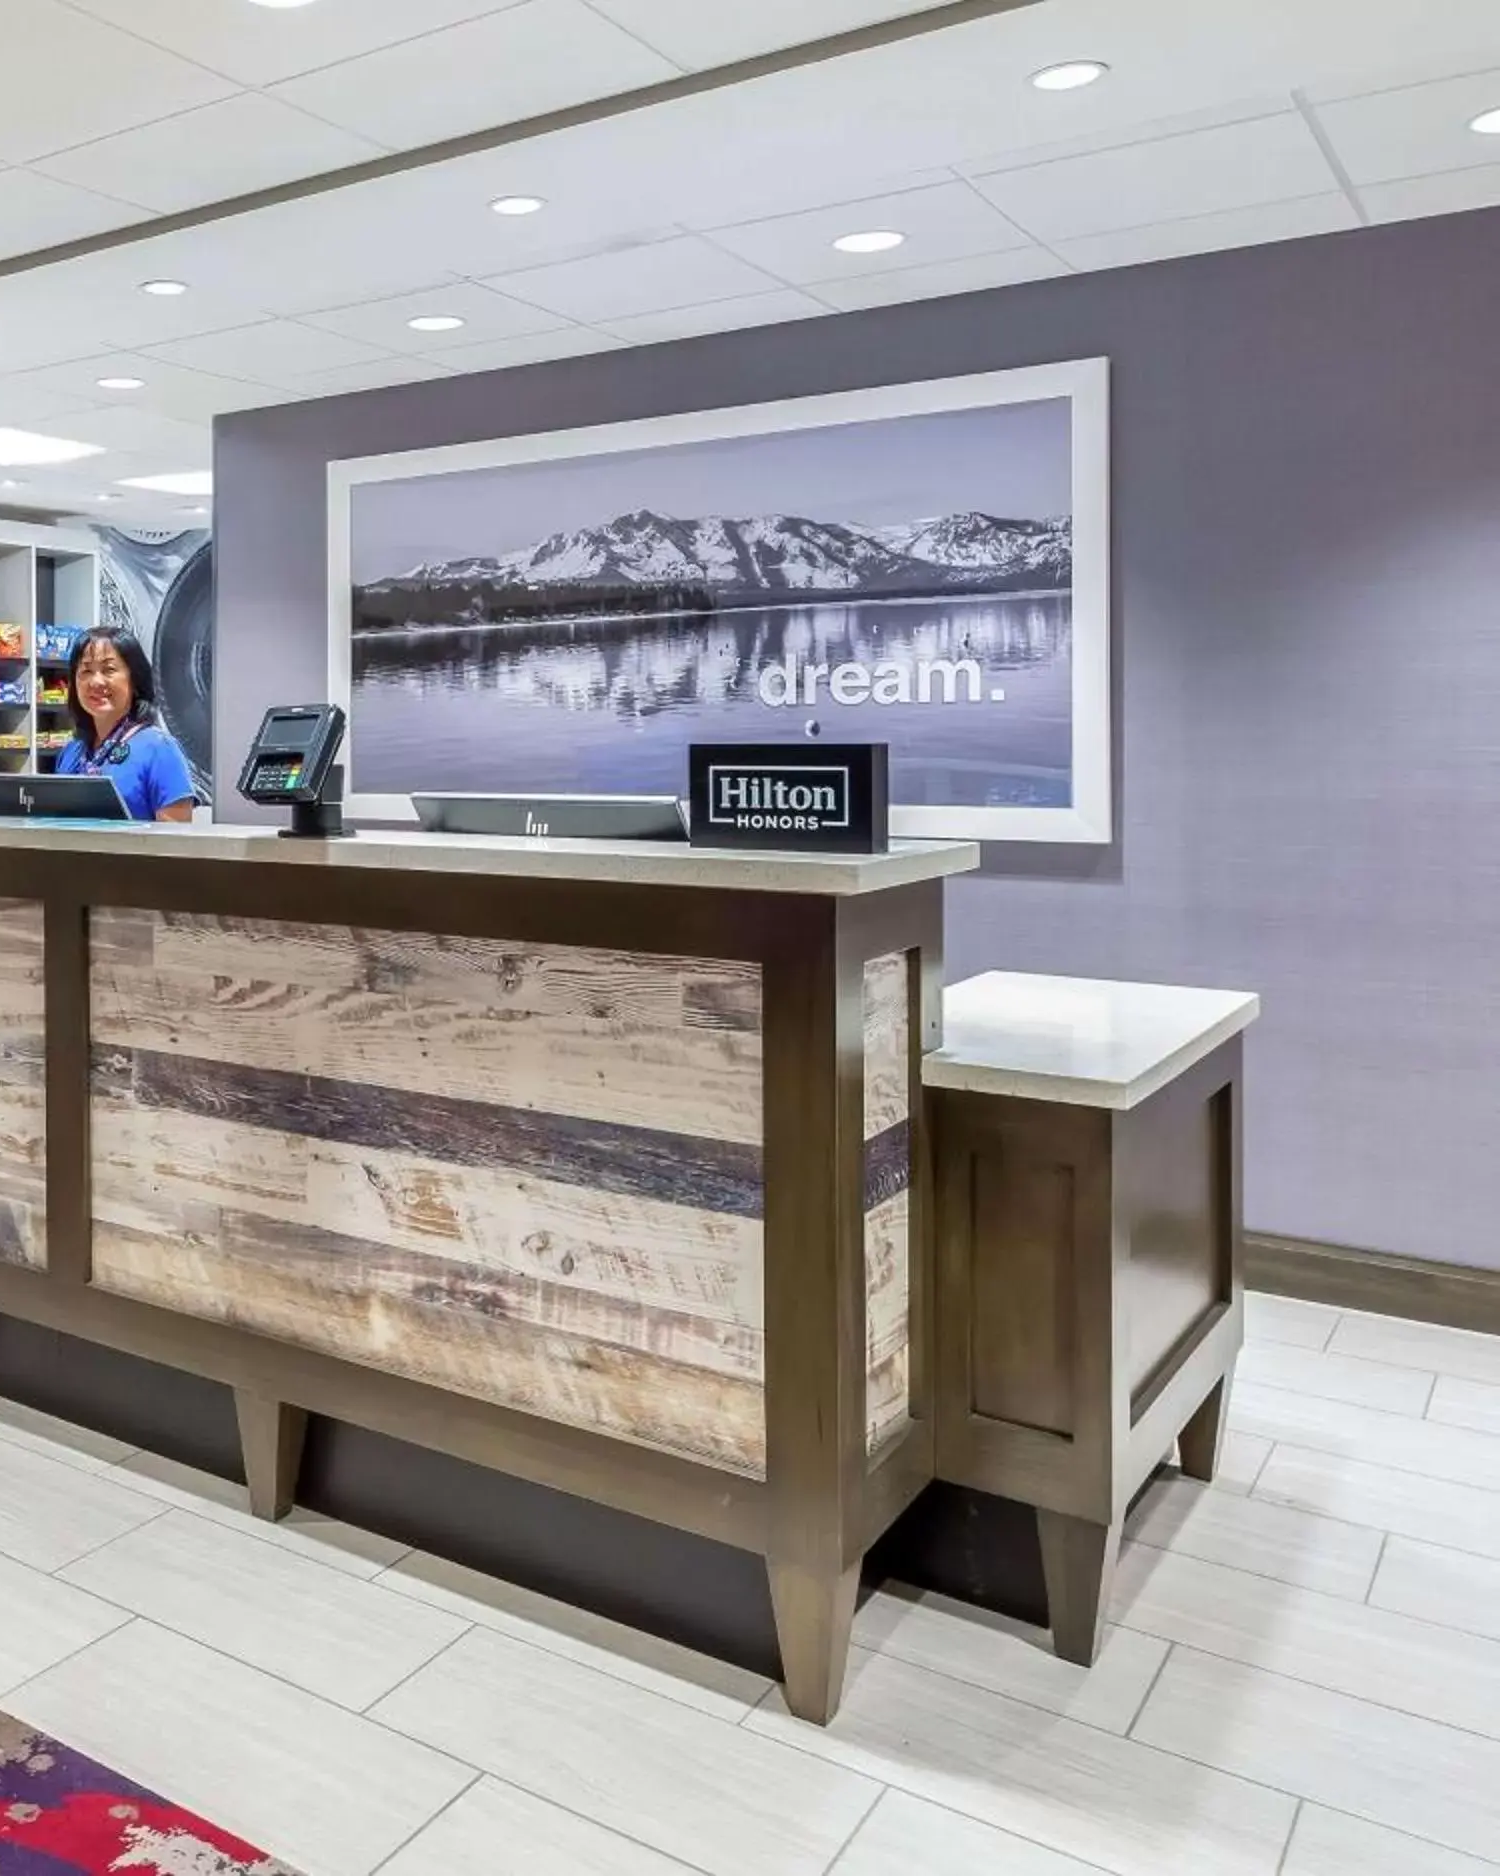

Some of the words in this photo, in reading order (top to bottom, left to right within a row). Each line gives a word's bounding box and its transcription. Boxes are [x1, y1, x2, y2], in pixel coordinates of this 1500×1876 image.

[758, 653, 1005, 707] dream.
[19, 786, 35, 813] hp
[719, 776, 837, 812] Hilton
[736, 814, 819, 830] HONORS
